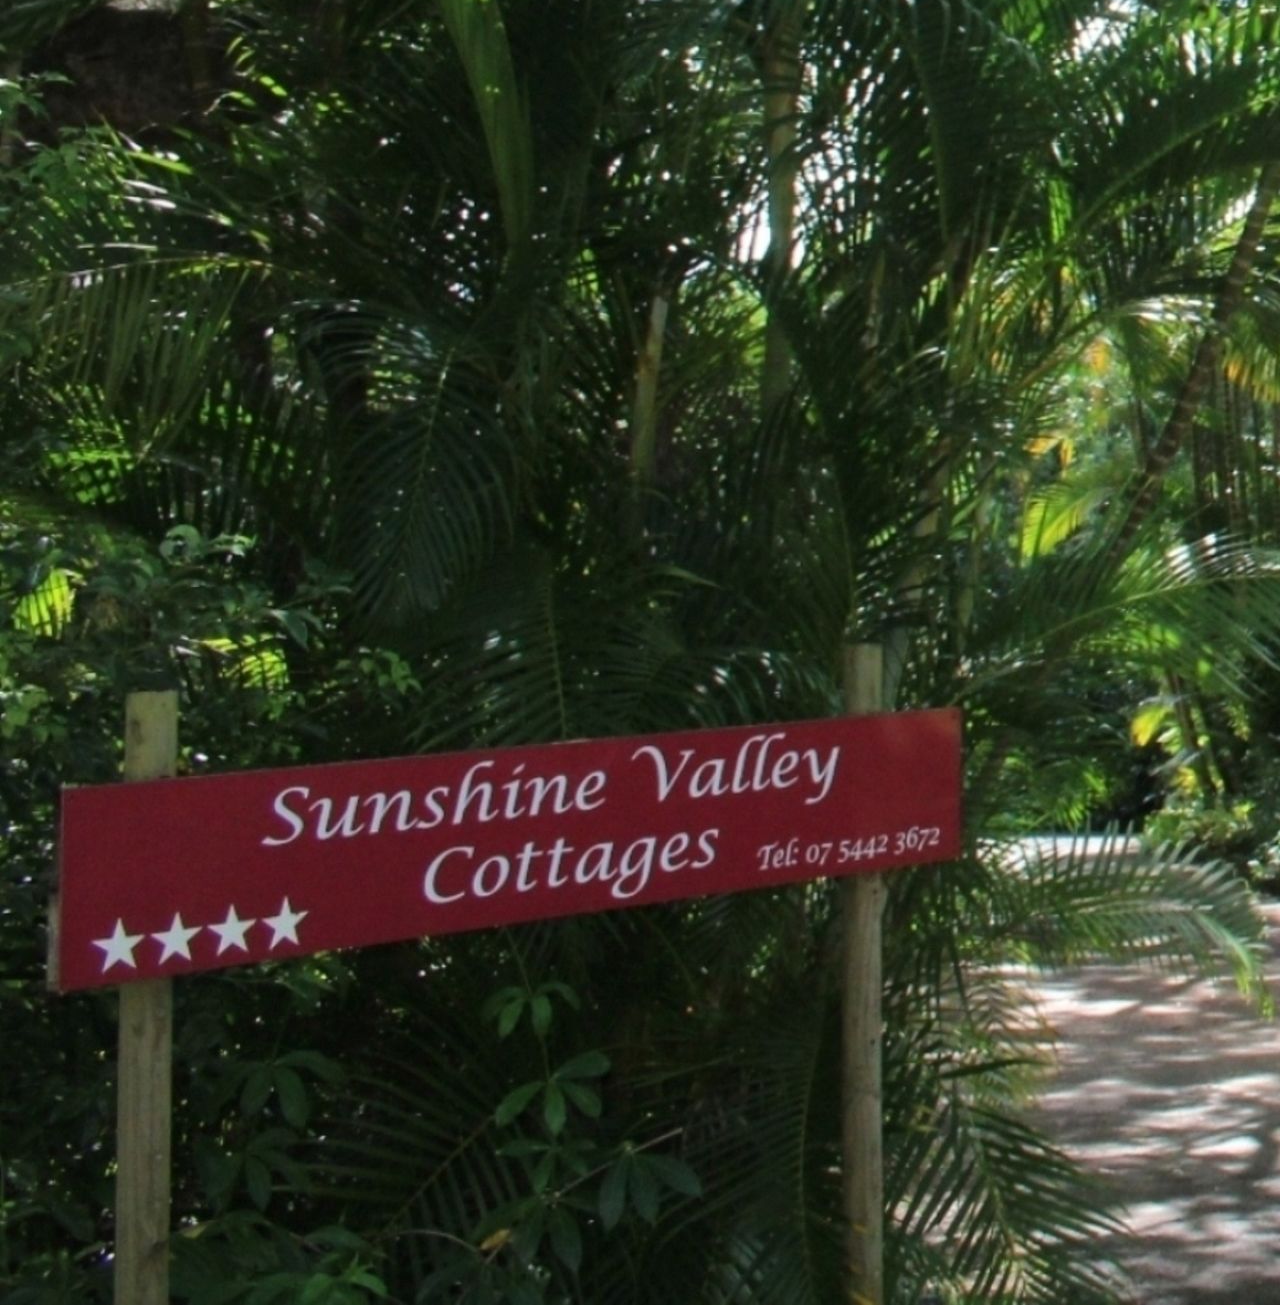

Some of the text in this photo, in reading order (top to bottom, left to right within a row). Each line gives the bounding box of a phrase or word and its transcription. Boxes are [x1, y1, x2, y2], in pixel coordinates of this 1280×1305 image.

[262, 732, 841, 847] Sunshine Valley
[421, 825, 719, 903] Cottages
[757, 826, 940, 871] Tel: 07 5442 3672
